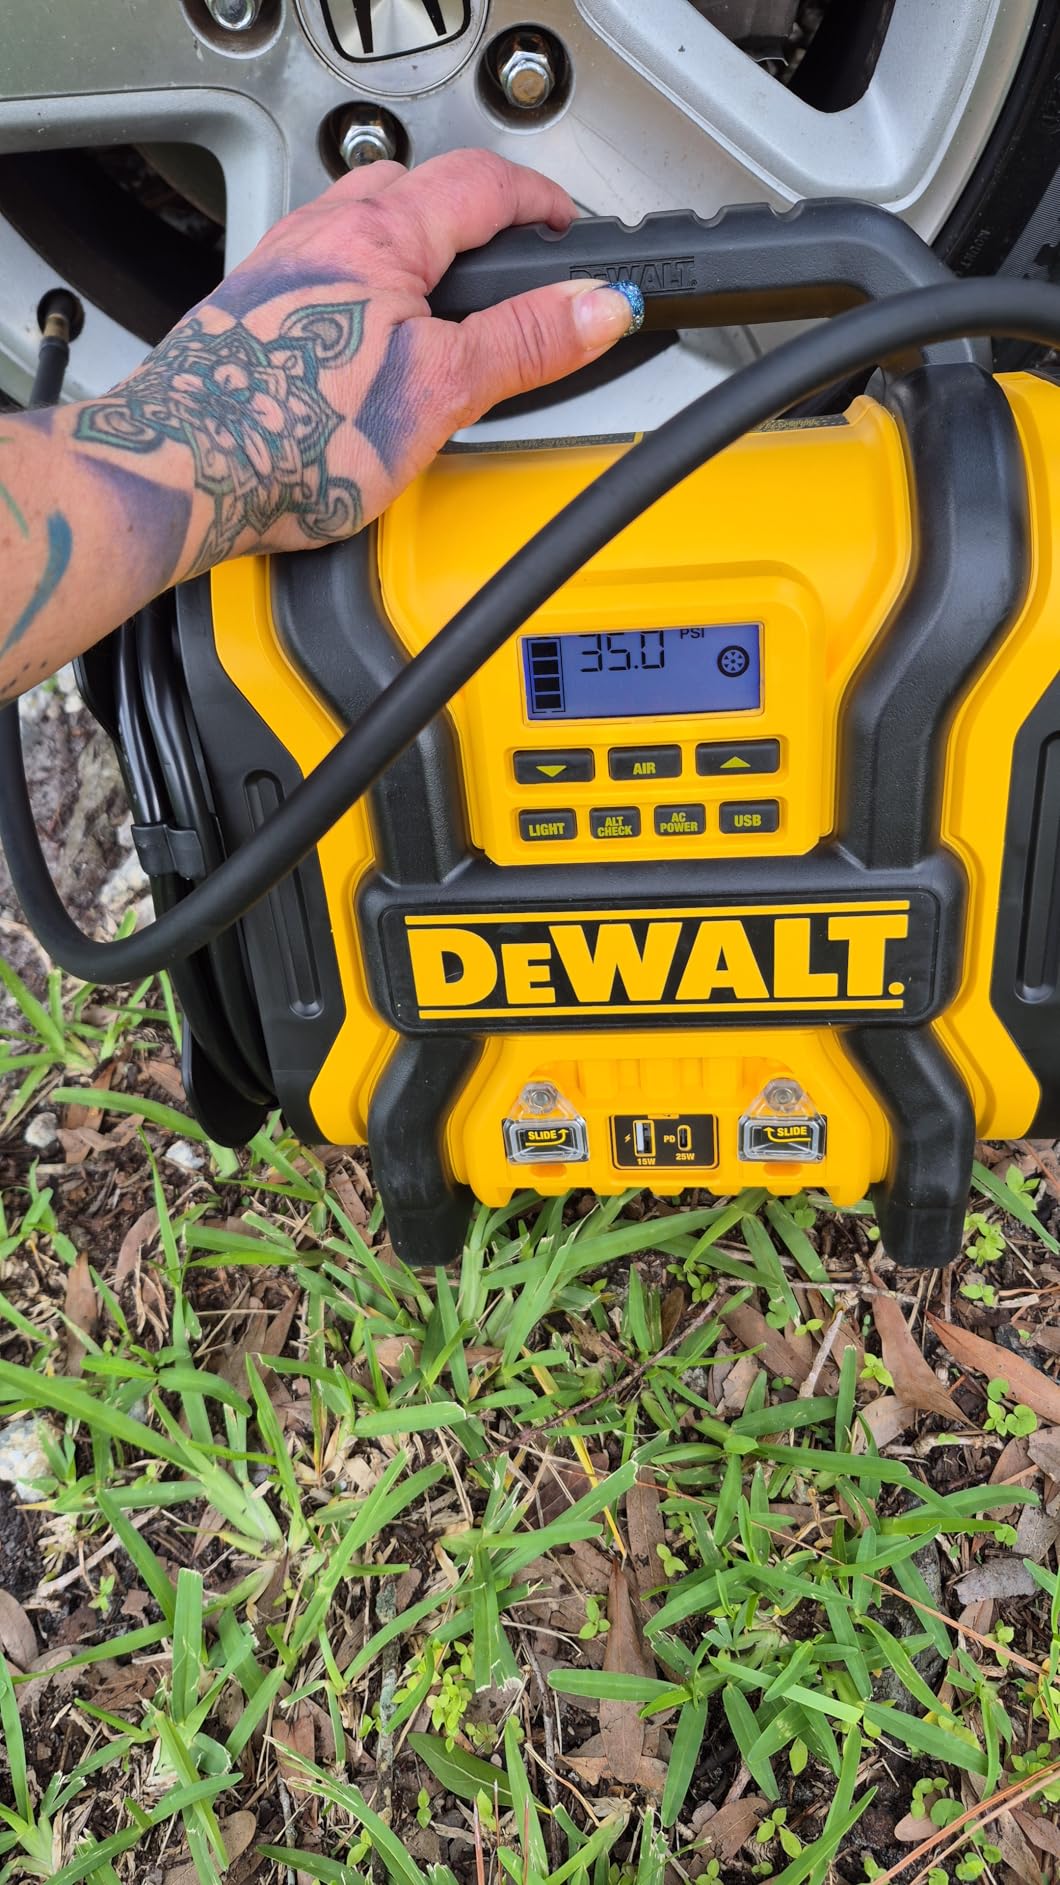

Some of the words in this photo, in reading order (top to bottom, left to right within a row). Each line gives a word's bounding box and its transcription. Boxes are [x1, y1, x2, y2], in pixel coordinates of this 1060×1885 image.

[578, 630, 664, 672] 35.0
[680, 628, 705, 639] PSI
[632, 762, 656, 775] AIR
[605, 816, 624, 826] ALT
[671, 812, 686, 822] AC
[734, 814, 762, 827] USB
[529, 822, 565, 837] LIGHT
[597, 825, 633, 837] CHECK
[660, 822, 699, 833] POWER
[528, 1130, 557, 1140] SLIDE
[777, 1127, 807, 1137] SLIDE
[663, 1135, 676, 1143] PD
[636, 1158, 656, 1166] 15W
[675, 1153, 695, 1161] 25W
